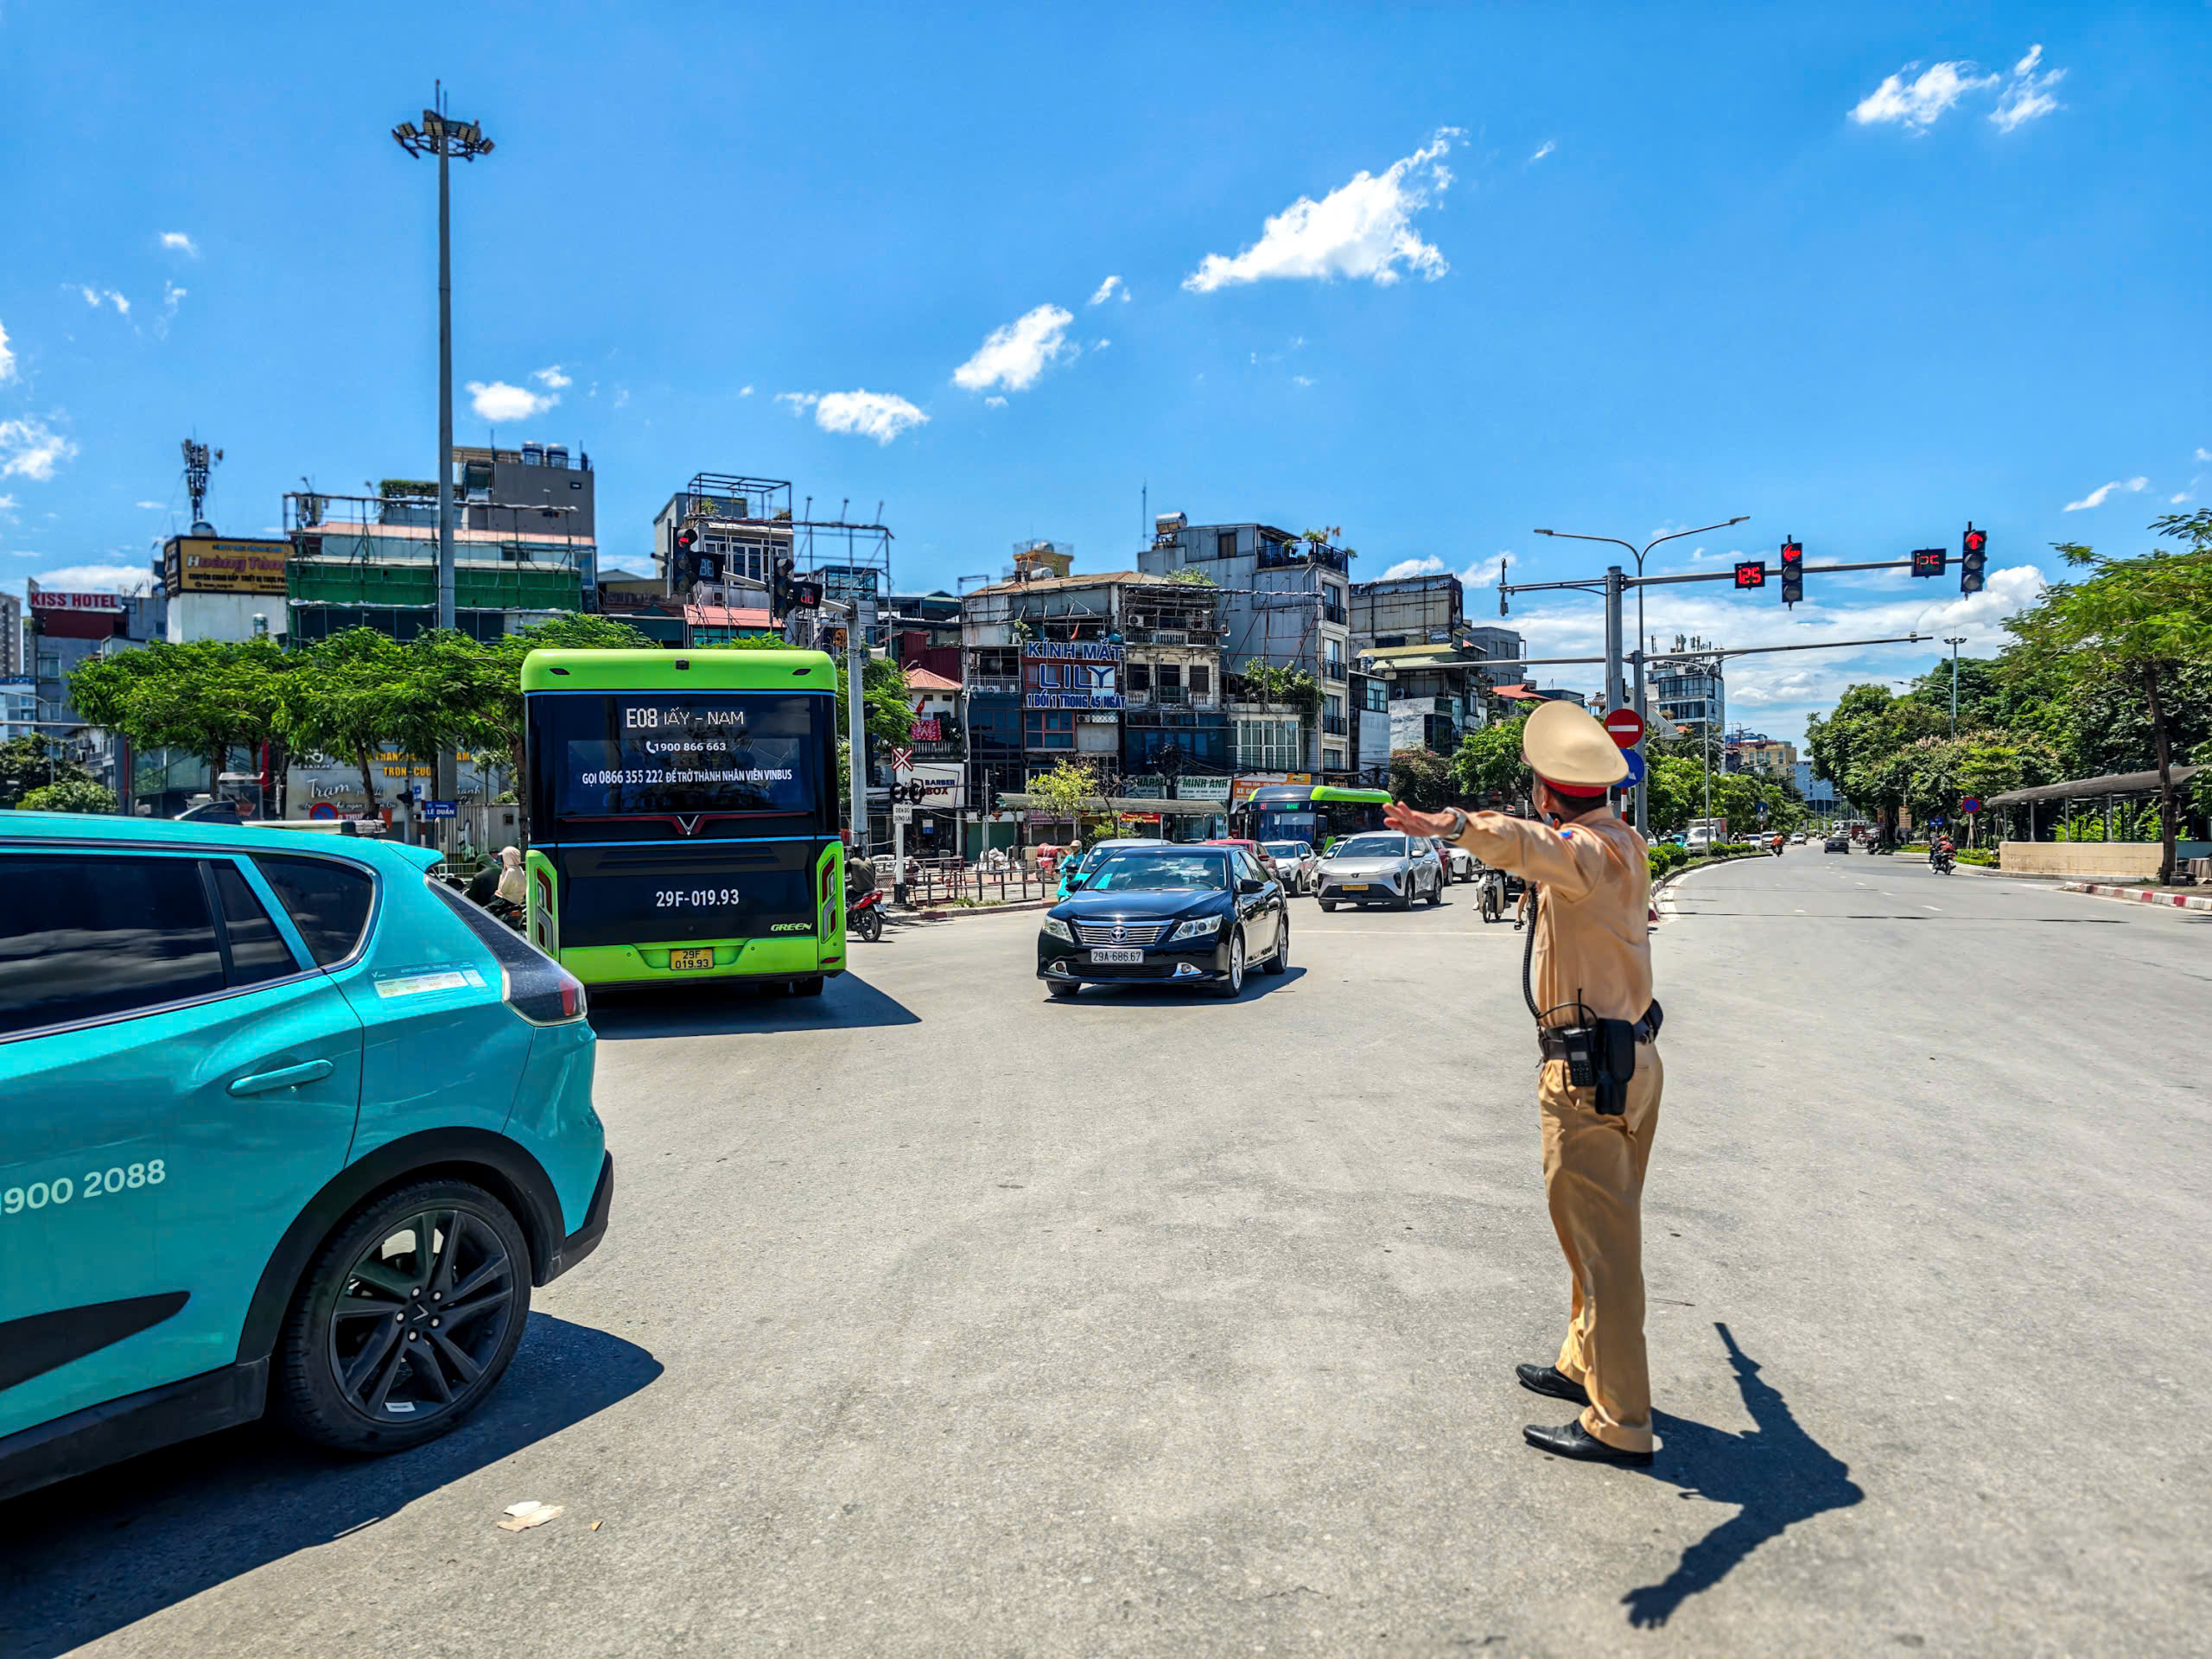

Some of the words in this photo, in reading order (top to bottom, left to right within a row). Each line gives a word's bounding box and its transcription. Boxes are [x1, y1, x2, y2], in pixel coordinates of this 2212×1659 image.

[30, 593, 67, 606] KISS
[72, 594, 118, 607] HOTEL
[1027, 638, 1076, 658] KÍNH
[1083, 638, 1123, 661] MẮT
[1039, 663, 1116, 690] LILY
[1058, 694, 1089, 709] TRONG
[1090, 696, 1102, 709] 45
[1103, 692, 1127, 709] NGÀY
[626, 708, 658, 728] E08
[707, 711, 744, 725] NAM
[654, 742, 681, 752] 1900
[683, 742, 703, 752] 866
[706, 742, 727, 752] 663
[582, 772, 597, 787] GỌI
[599, 770, 624, 785] 0866
[626, 769, 644, 784] 355
[645, 769, 664, 783] 222
[693, 768, 721, 782] THÀNH
[722, 767, 745, 781] NHÂN
[746, 767, 764, 781] VIÊN
[764, 769, 792, 781] VINBUS
[656, 888, 740, 907] 29F-019.93
[771, 923, 812, 931] GREEN
[683, 950, 701, 959] 29F
[1093, 951, 1141, 962] 29A-686.67
[675, 959, 709, 969] 019.93
[0, 1177, 74, 1214] 900
[83, 1159, 166, 1198] 2088
